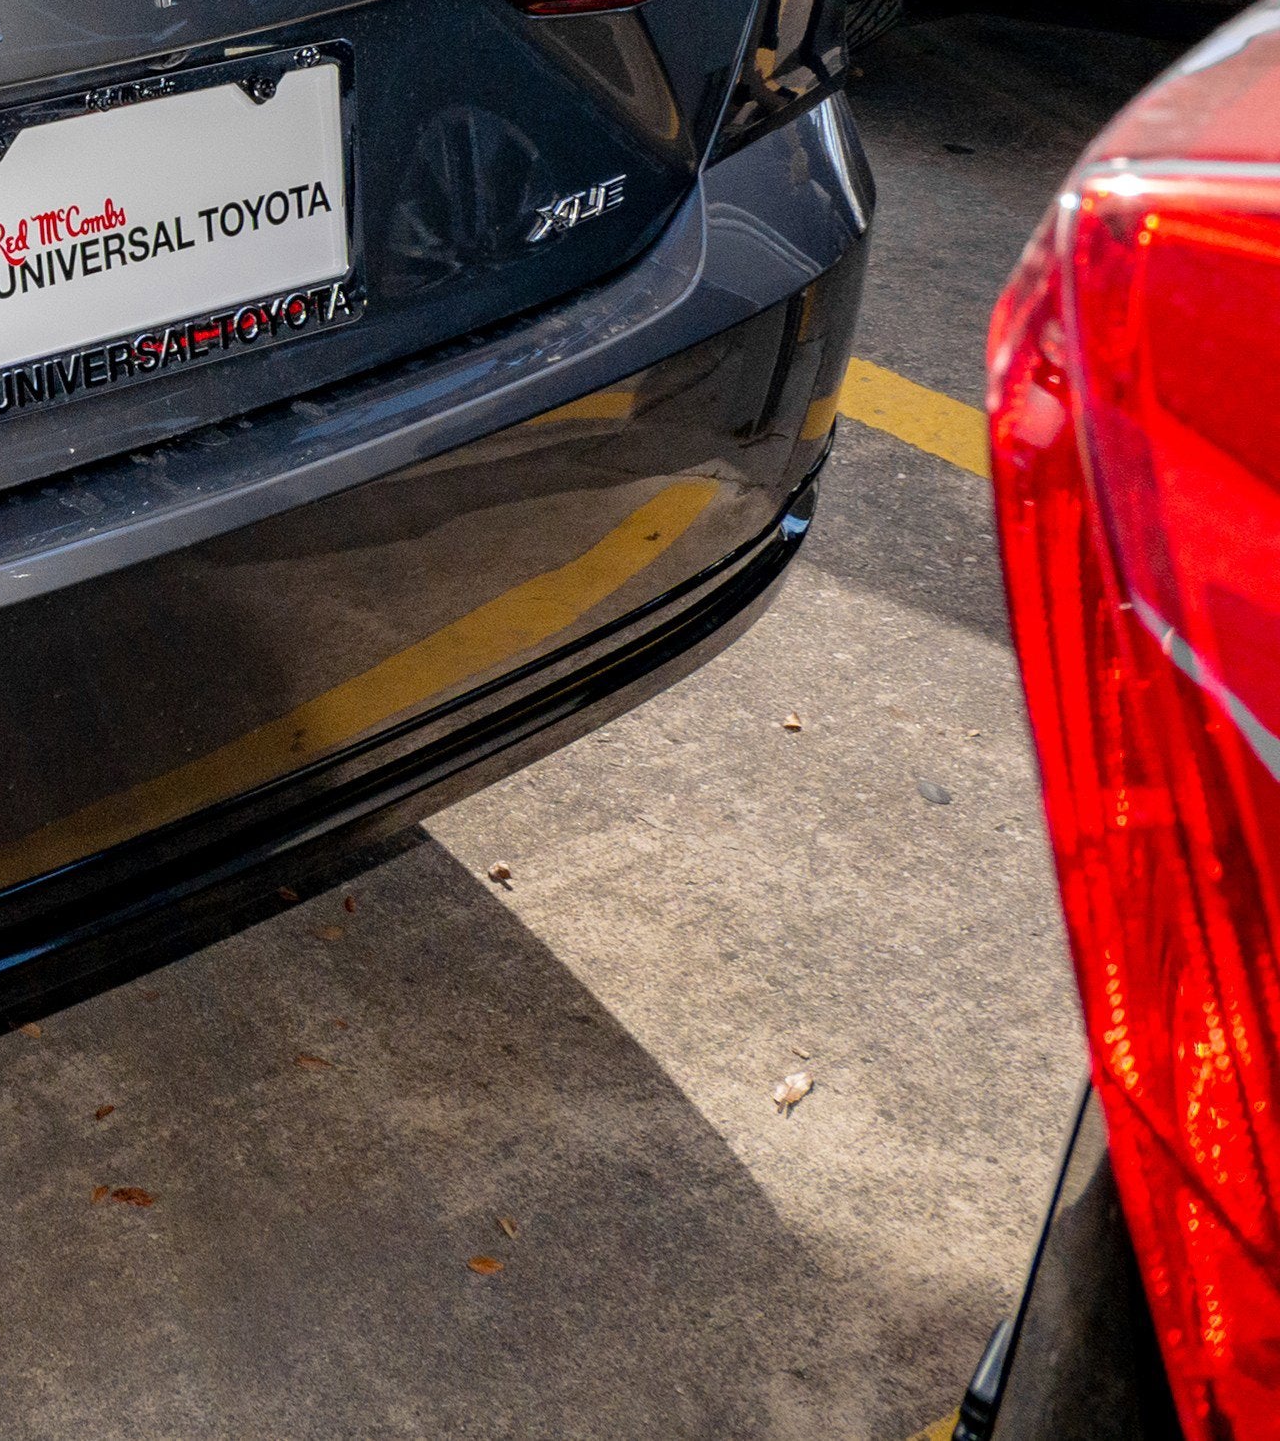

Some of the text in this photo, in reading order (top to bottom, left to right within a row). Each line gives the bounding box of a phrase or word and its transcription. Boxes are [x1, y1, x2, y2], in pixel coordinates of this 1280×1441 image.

[31, 198, 127, 246] McCombs
[198, 181, 332, 243] TOYOTA
[525, 173, 628, 242] XLE
[214, 281, 354, 350] TOYOTA
